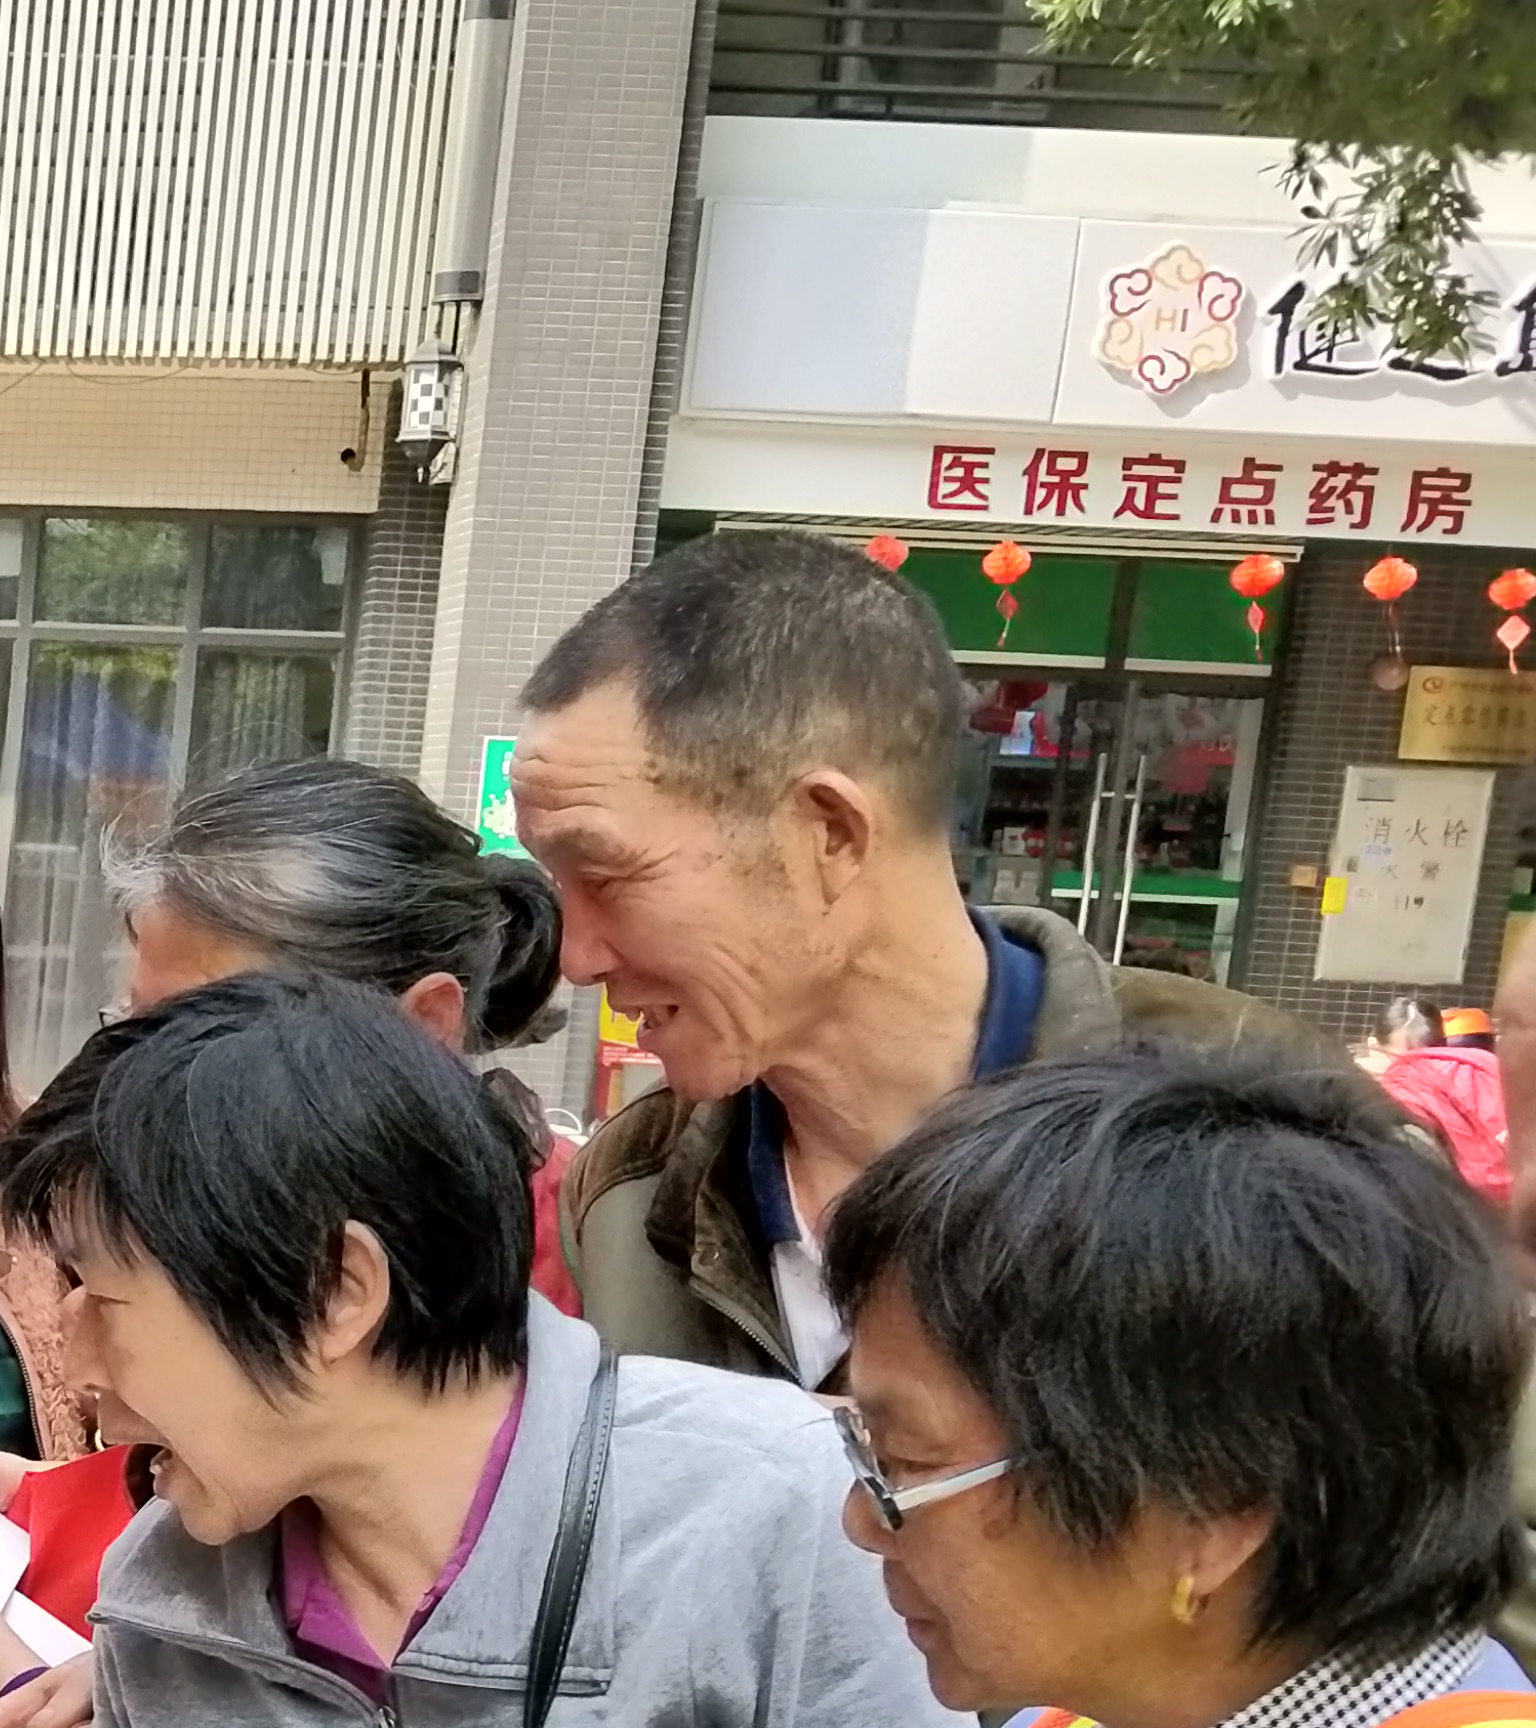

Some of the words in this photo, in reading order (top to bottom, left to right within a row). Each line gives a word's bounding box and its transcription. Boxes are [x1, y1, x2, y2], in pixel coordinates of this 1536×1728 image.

[928, 445, 1473, 535] 医保定点药房
[1365, 816, 1470, 848] 消火栓
